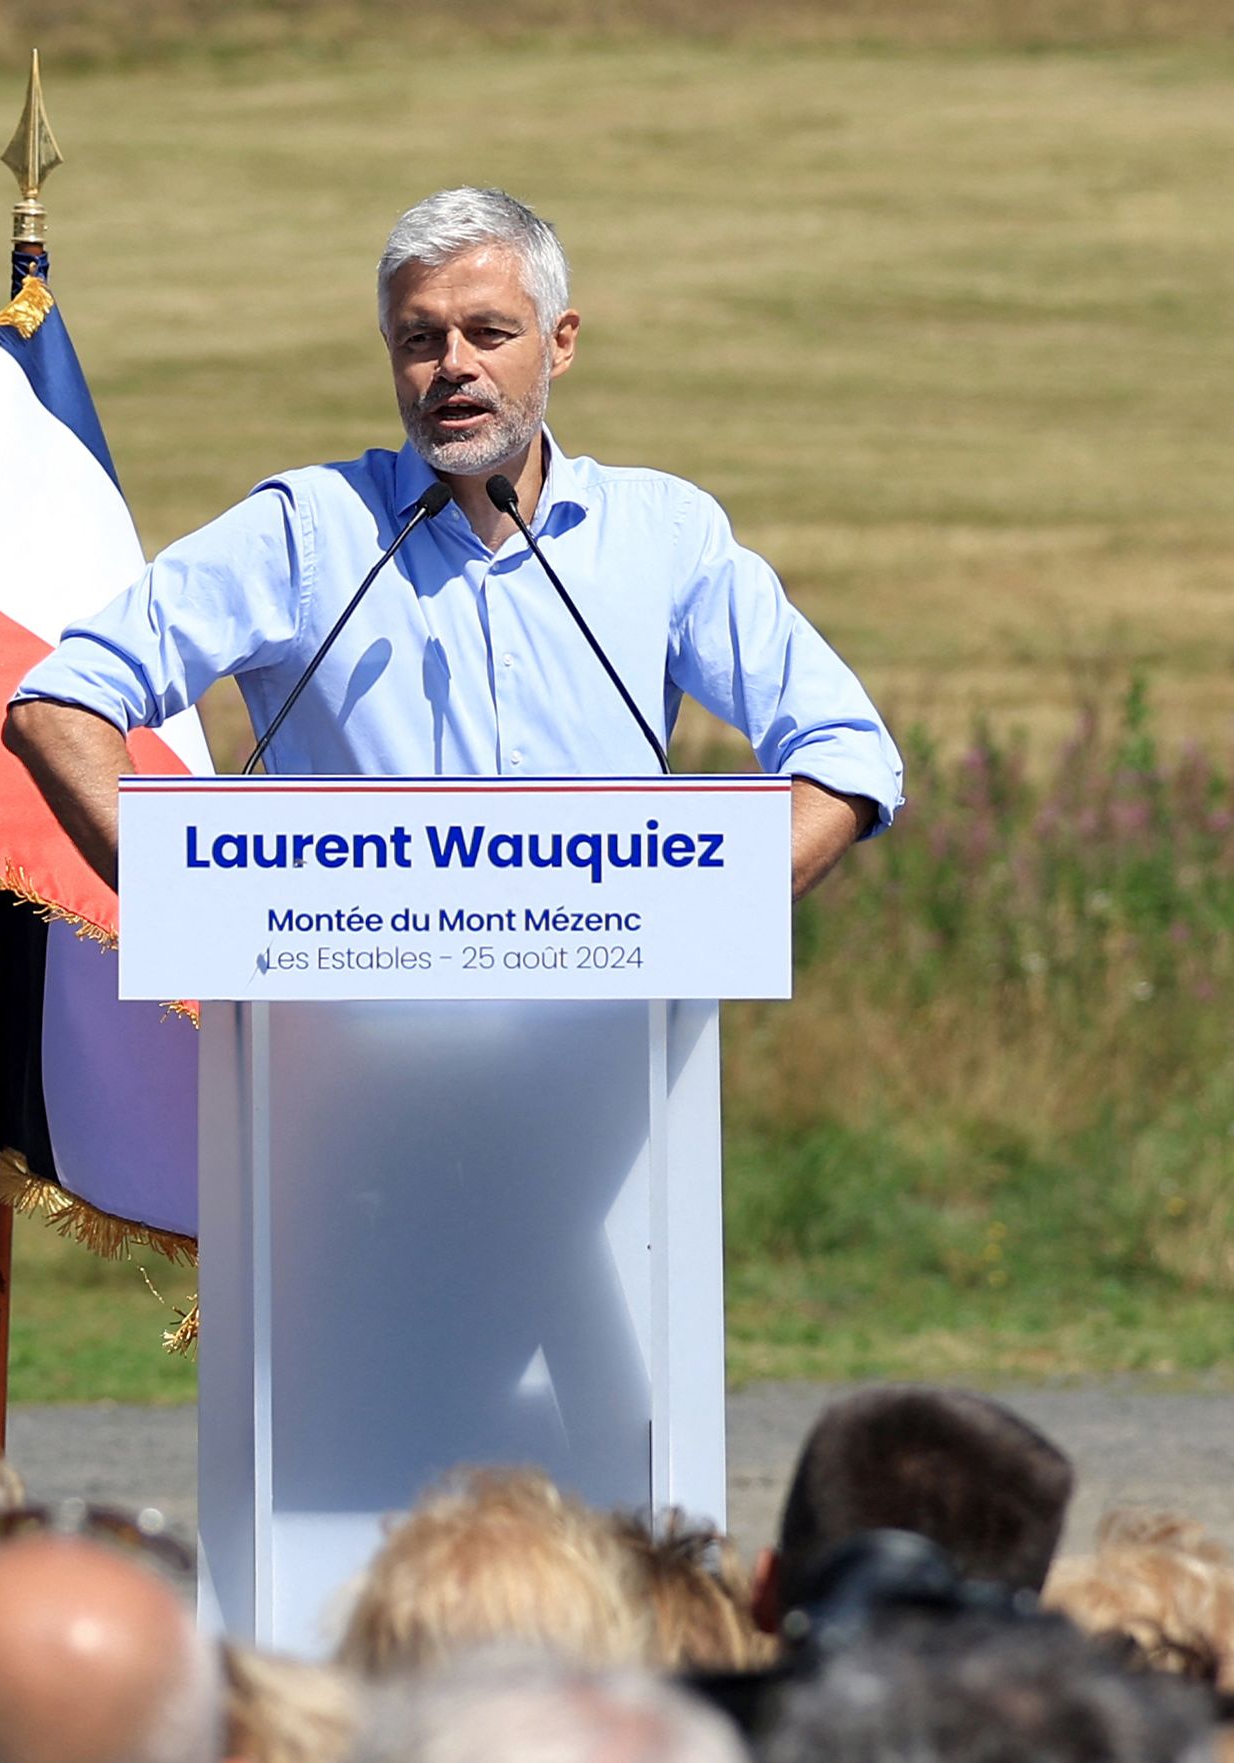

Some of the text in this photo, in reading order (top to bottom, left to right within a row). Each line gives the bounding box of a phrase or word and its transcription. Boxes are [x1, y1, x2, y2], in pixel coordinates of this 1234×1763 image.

[186, 819, 725, 884] Laurent Wauquiez
[268, 905, 642, 933] Montée du Mont Mézenc
[266, 947, 310, 970] Les
[317, 945, 432, 970] Estables
[462, 945, 495, 970] 25
[502, 945, 569, 970] août
[576, 945, 644, 970] 2024
